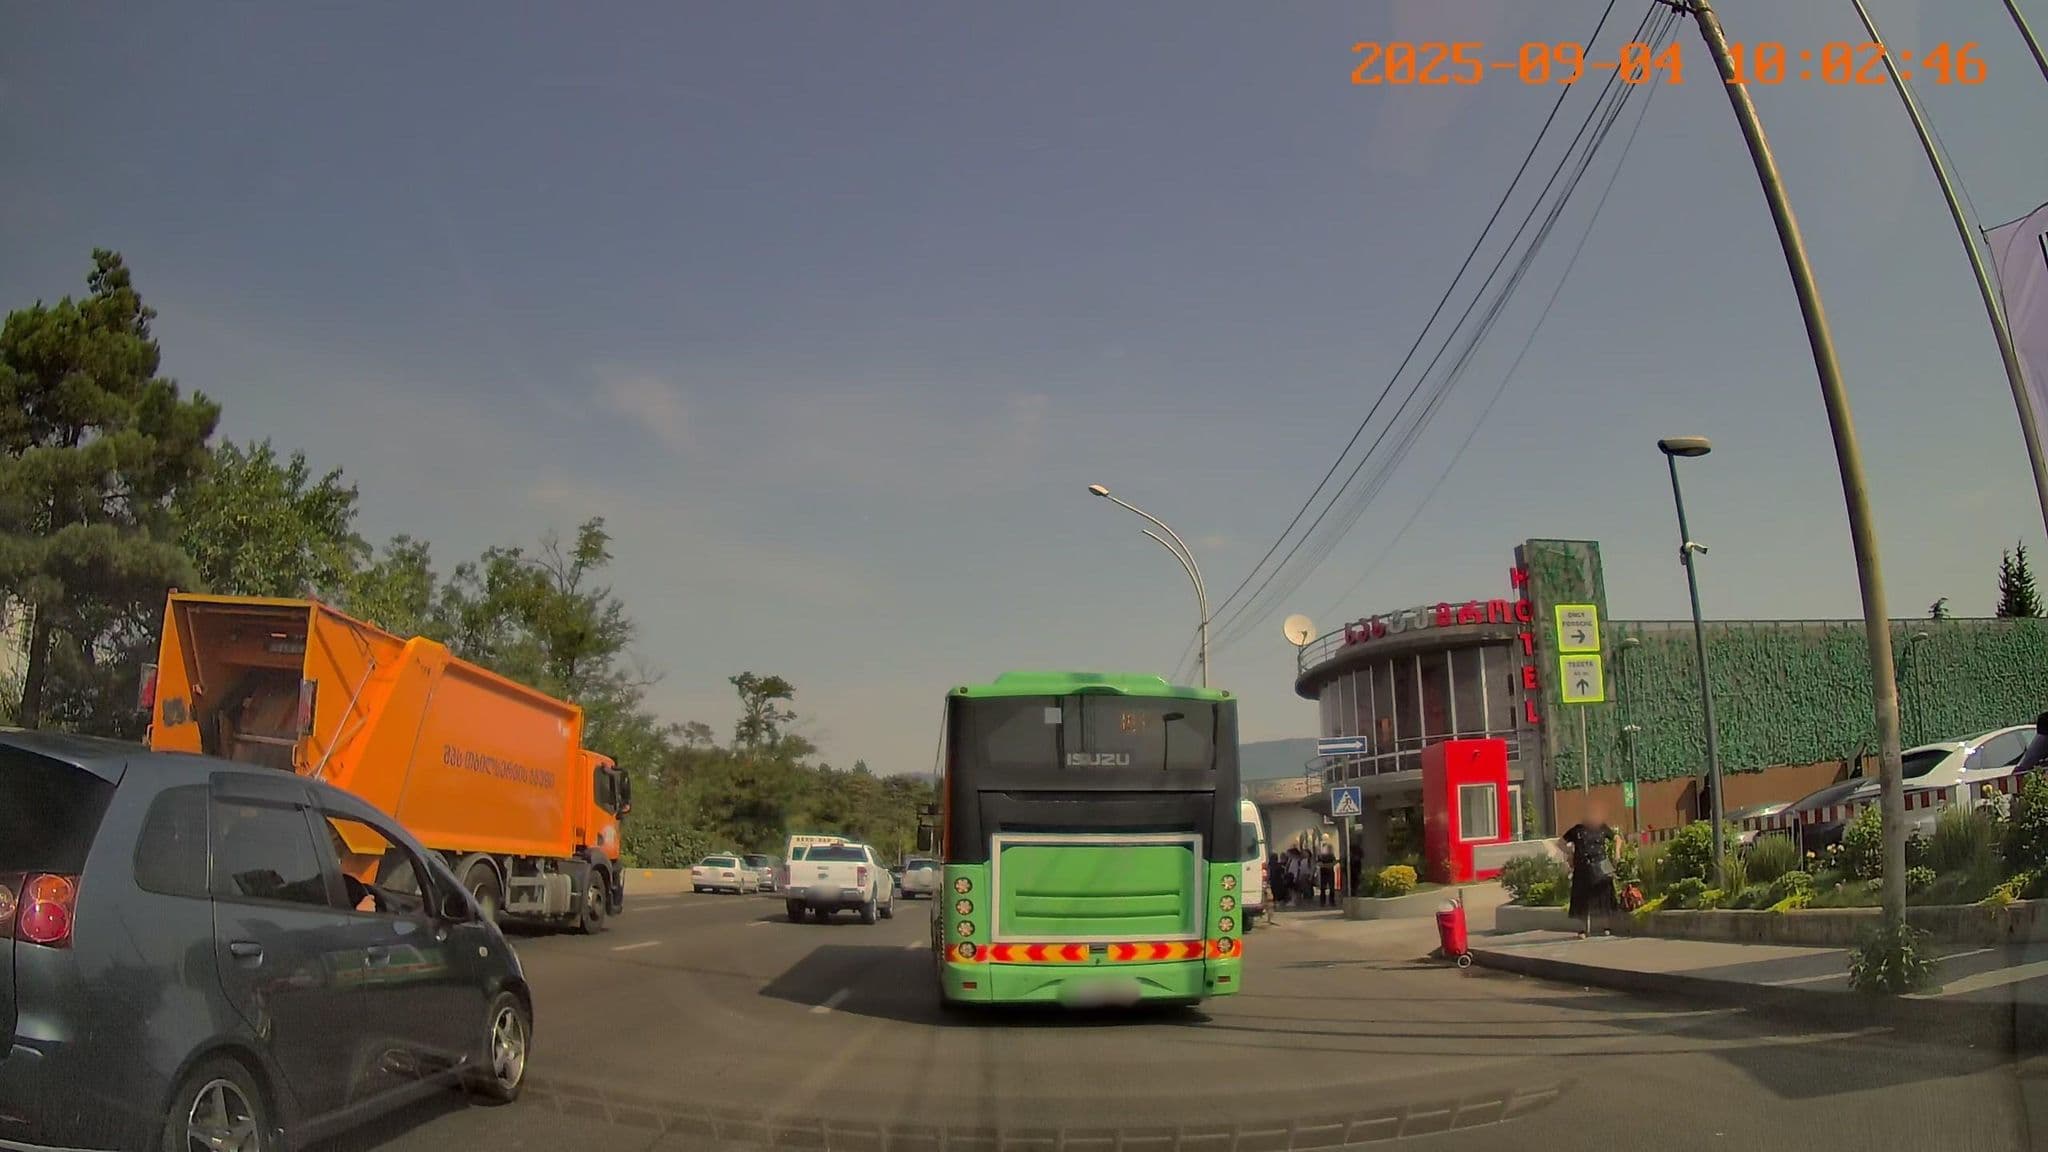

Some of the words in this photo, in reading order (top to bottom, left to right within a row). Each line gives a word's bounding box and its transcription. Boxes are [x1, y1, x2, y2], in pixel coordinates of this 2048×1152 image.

[1344, 598, 1512, 645] სასტუმრო
[1510, 567, 1540, 724] HOTEL
[1066, 753, 1130, 766] ISUZU
